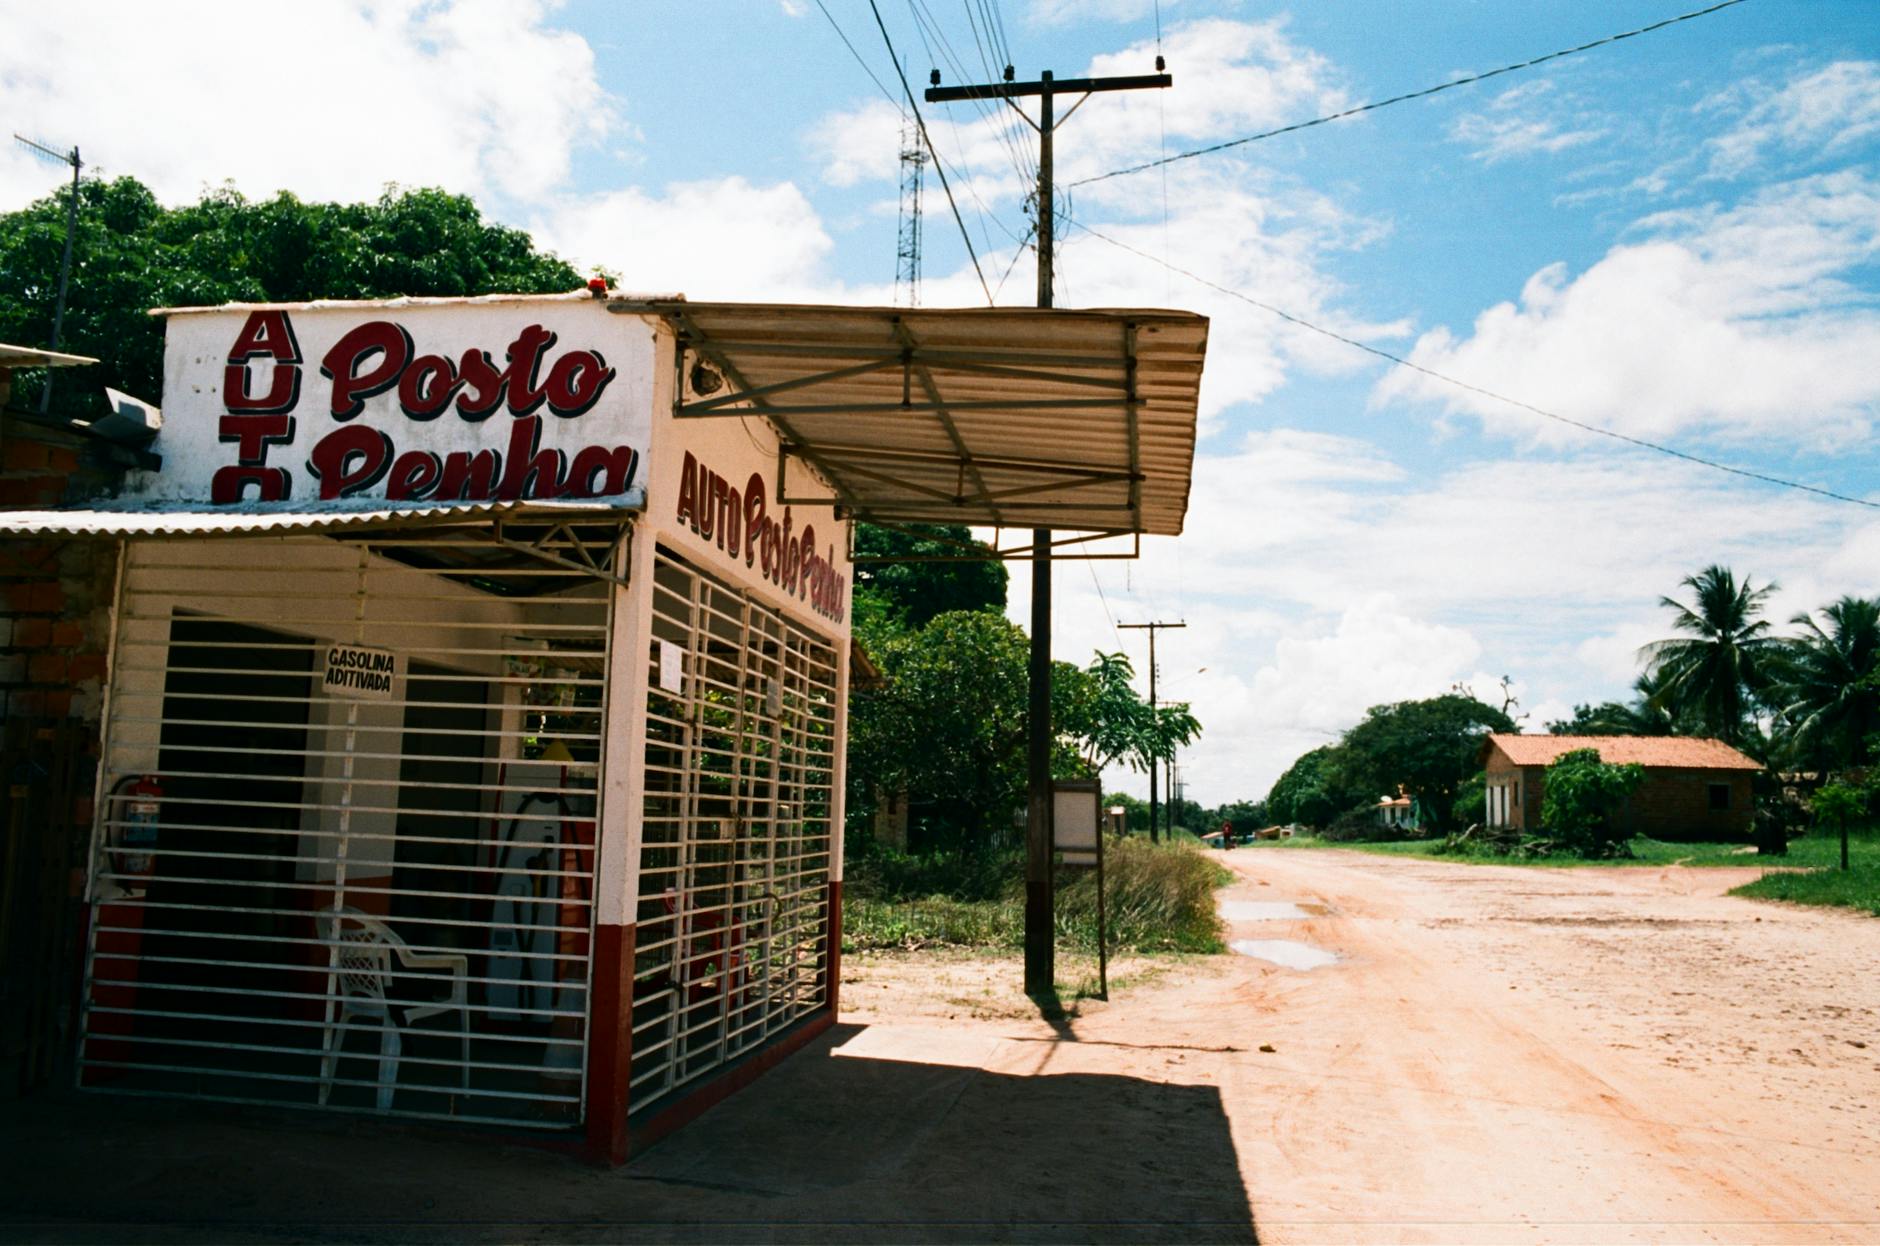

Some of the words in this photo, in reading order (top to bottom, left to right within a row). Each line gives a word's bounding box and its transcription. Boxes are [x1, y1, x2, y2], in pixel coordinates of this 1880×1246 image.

[211, 310, 302, 503] AUTO
[320, 321, 615, 421] Posto
[306, 414, 638, 501] Penha
[677, 450, 742, 559] AUTO
[743, 472, 800, 597] Posto
[325, 667, 390, 692] ADITIVADA
[329, 648, 394, 673] GASOLINA
